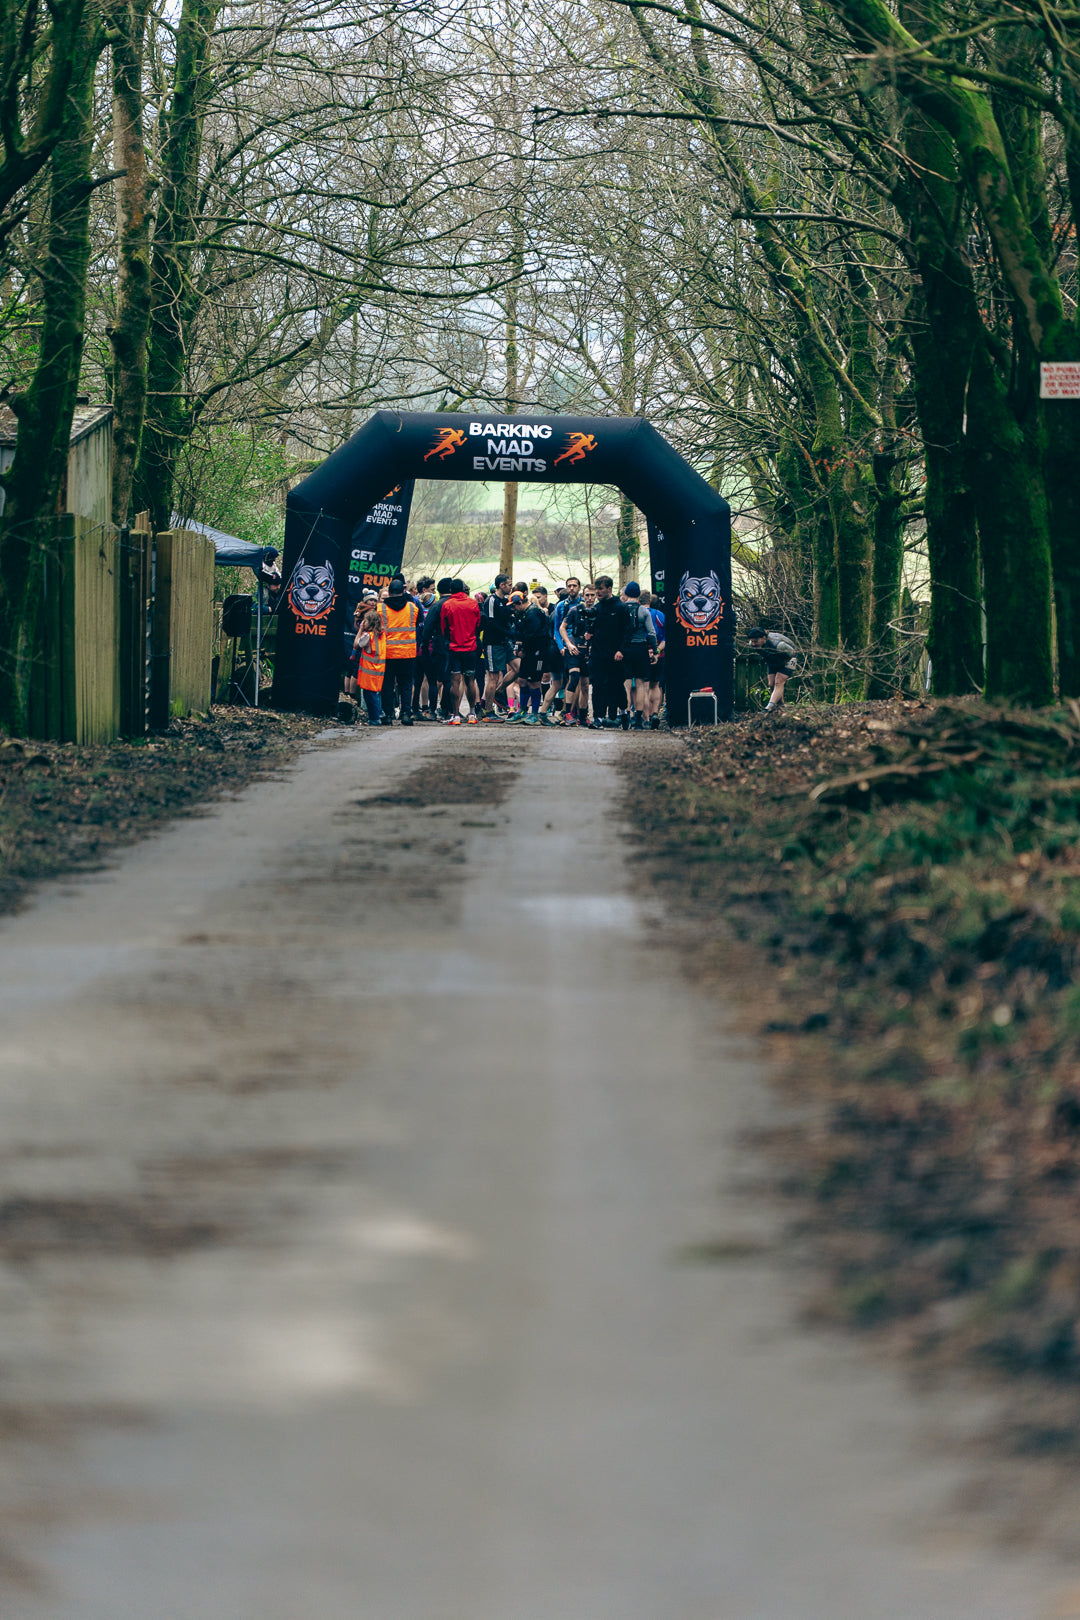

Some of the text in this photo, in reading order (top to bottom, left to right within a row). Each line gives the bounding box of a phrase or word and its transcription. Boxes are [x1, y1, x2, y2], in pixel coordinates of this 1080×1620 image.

[469, 422, 552, 439] BARKING
[487, 439, 534, 456] MAD
[473, 456, 547, 472] EVENTS
[371, 502, 403, 513] ARKING
[373, 509, 393, 519] MAD
[365, 515, 398, 526] EVENTS
[351, 549, 376, 561] GET
[349, 559, 398, 576] READY
[347, 575, 360, 584] TO
[295, 622, 327, 636] BME
[686, 634, 718, 647] BME
